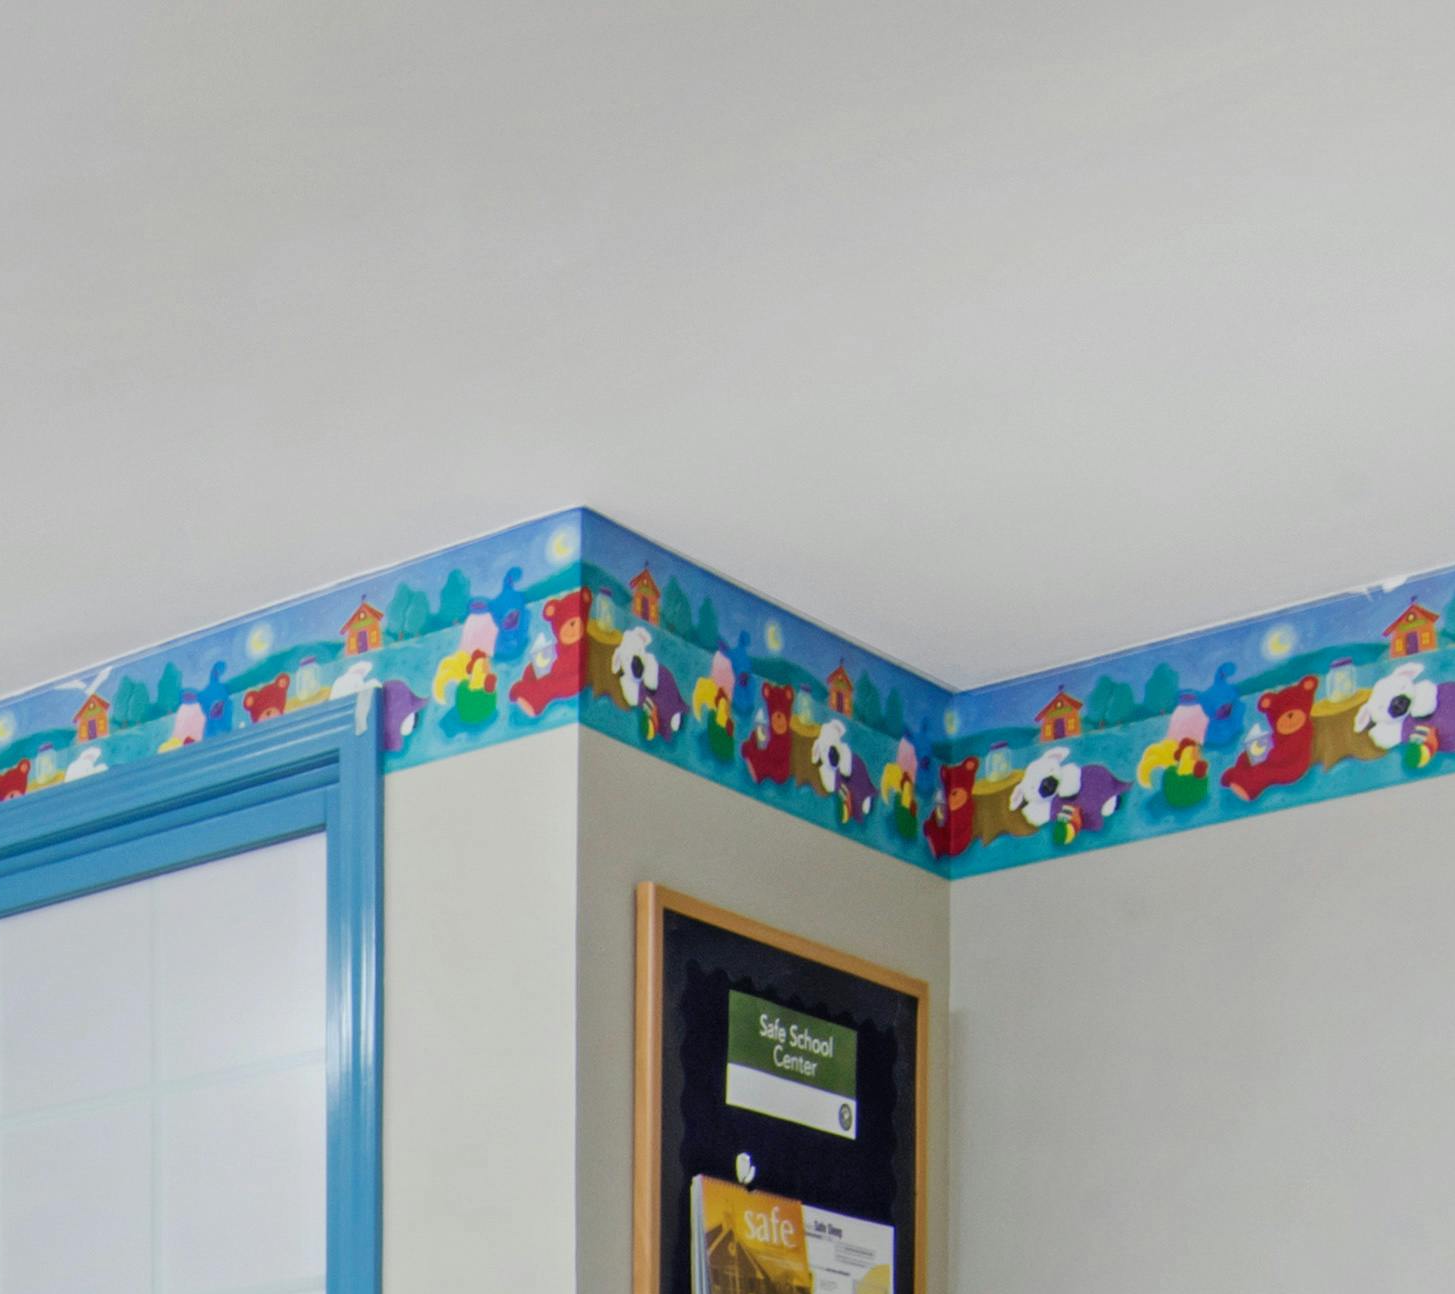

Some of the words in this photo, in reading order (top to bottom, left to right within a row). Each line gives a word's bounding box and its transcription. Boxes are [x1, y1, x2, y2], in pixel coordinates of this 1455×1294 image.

[759, 1013, 786, 1043] Safe
[789, 1024, 834, 1058] School
[773, 1044, 818, 1076] Center
[743, 1205, 797, 1249] safe
